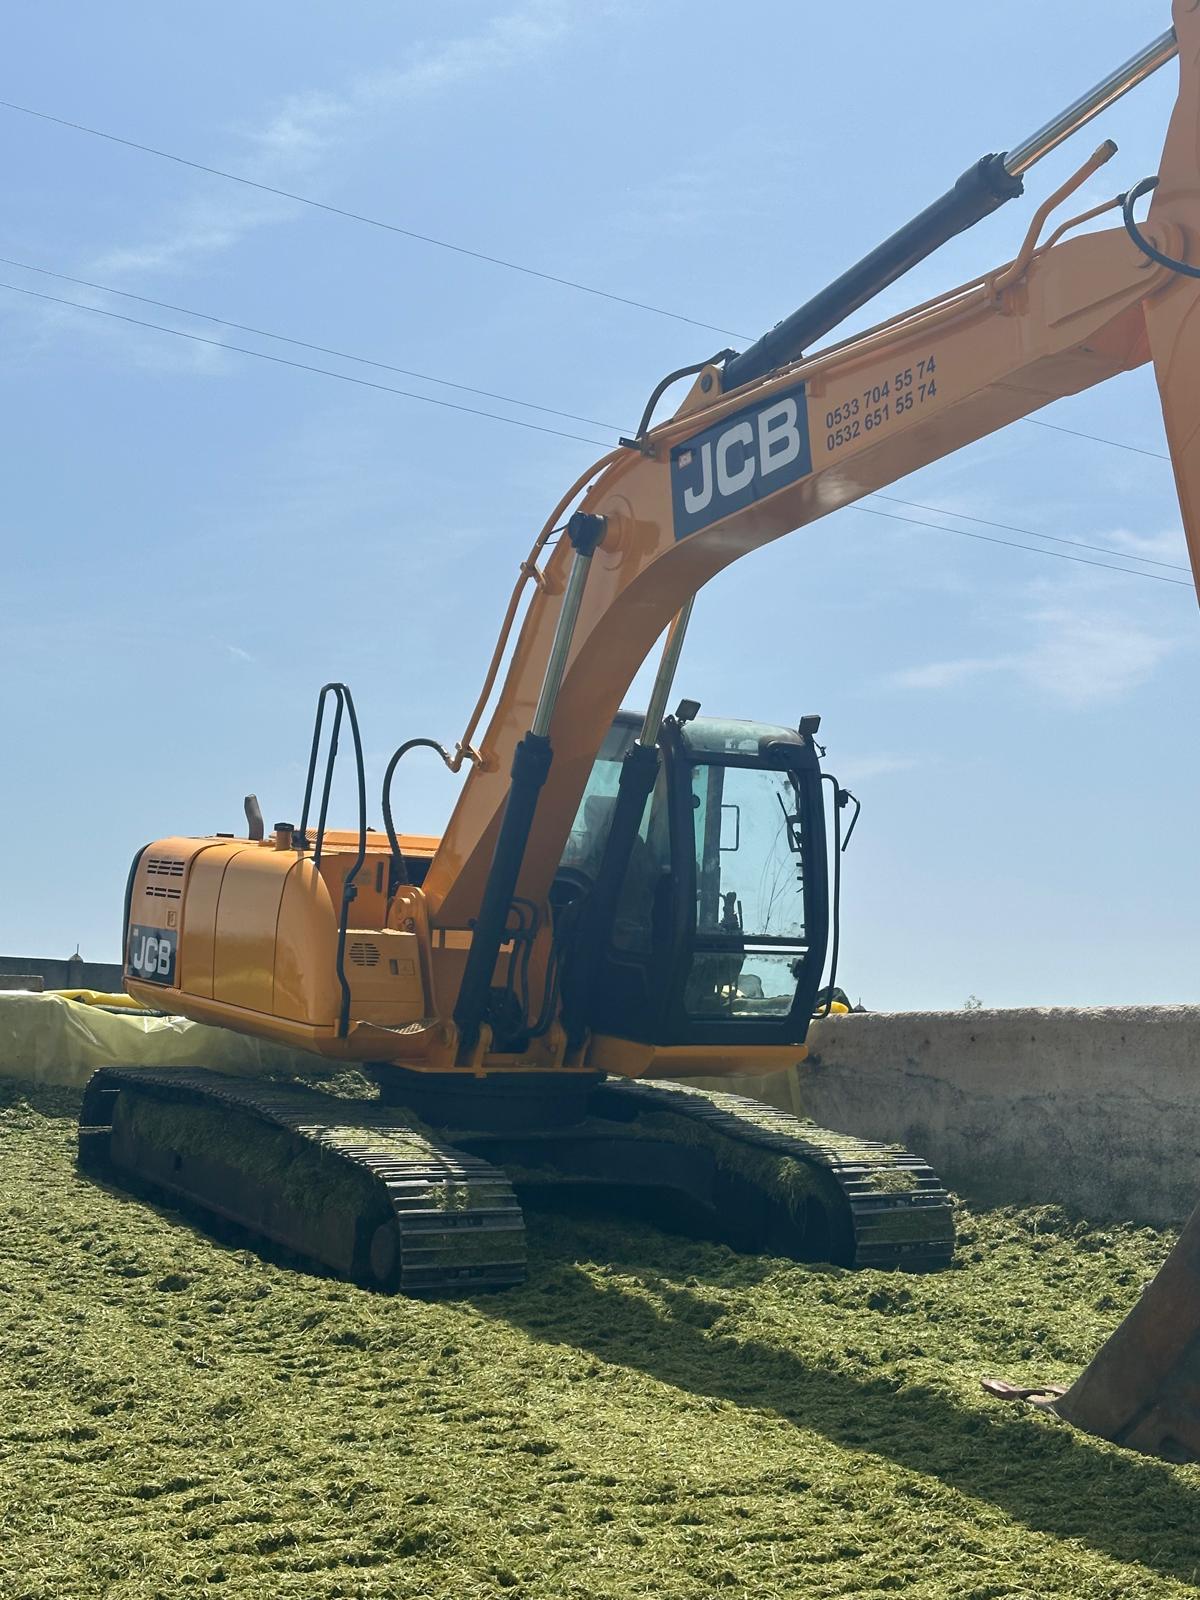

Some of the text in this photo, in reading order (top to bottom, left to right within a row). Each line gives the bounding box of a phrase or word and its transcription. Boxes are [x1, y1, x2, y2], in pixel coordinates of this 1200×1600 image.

[826, 355, 936, 429] 0533 704 55 74
[827, 379, 937, 451] 0532 651 55 74
[684, 398, 800, 514] JCB
[133, 935, 171, 975] JCB
